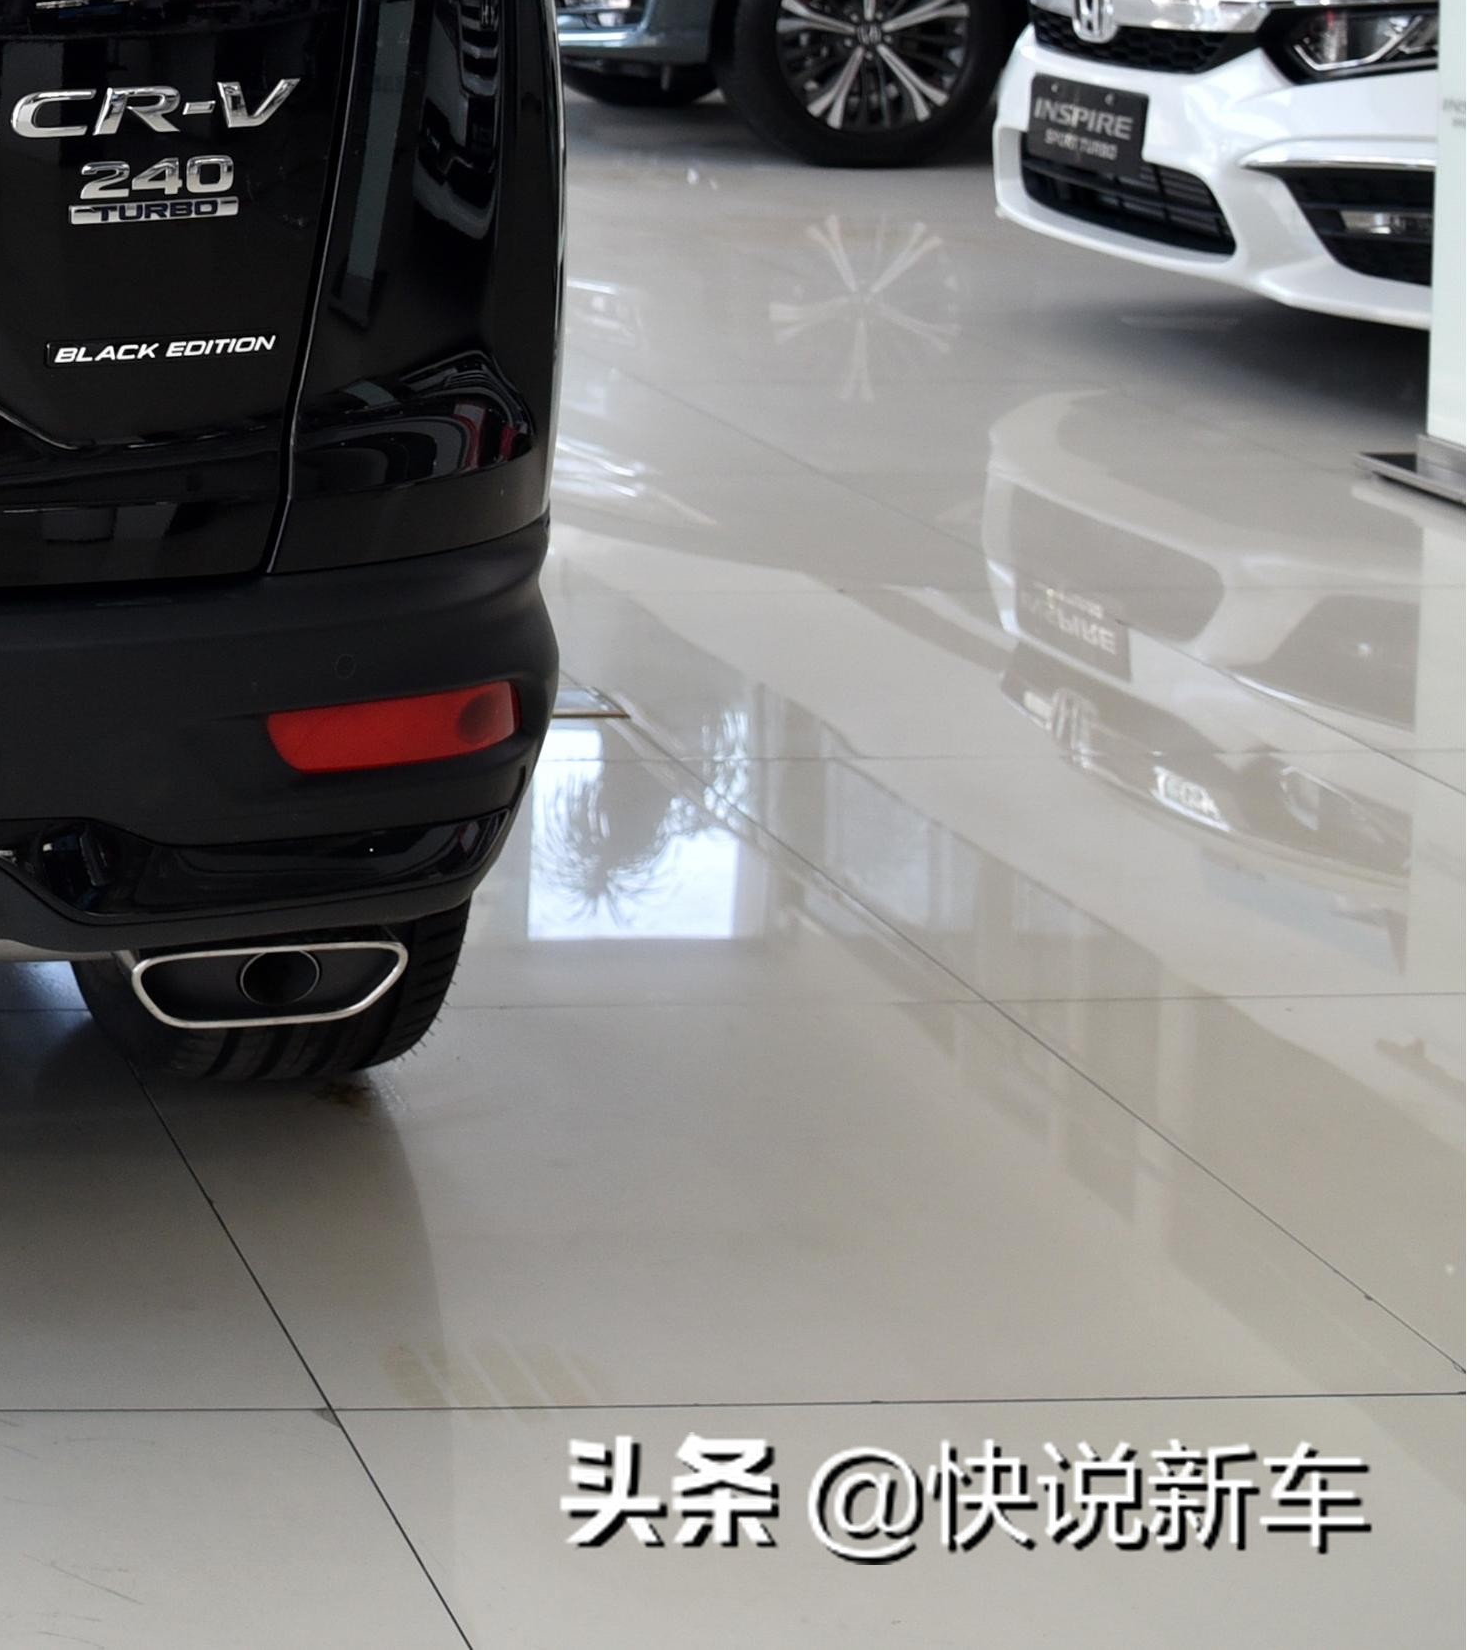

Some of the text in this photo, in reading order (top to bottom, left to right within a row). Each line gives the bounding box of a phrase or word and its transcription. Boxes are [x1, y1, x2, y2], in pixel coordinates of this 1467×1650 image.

[10, 78, 301, 139] CR-V
[1034, 97, 1134, 141] INSPIRE
[80, 155, 234, 200] 240
[94, 199, 220, 222] TURBO
[53, 334, 277, 364] BLACK EDITION
